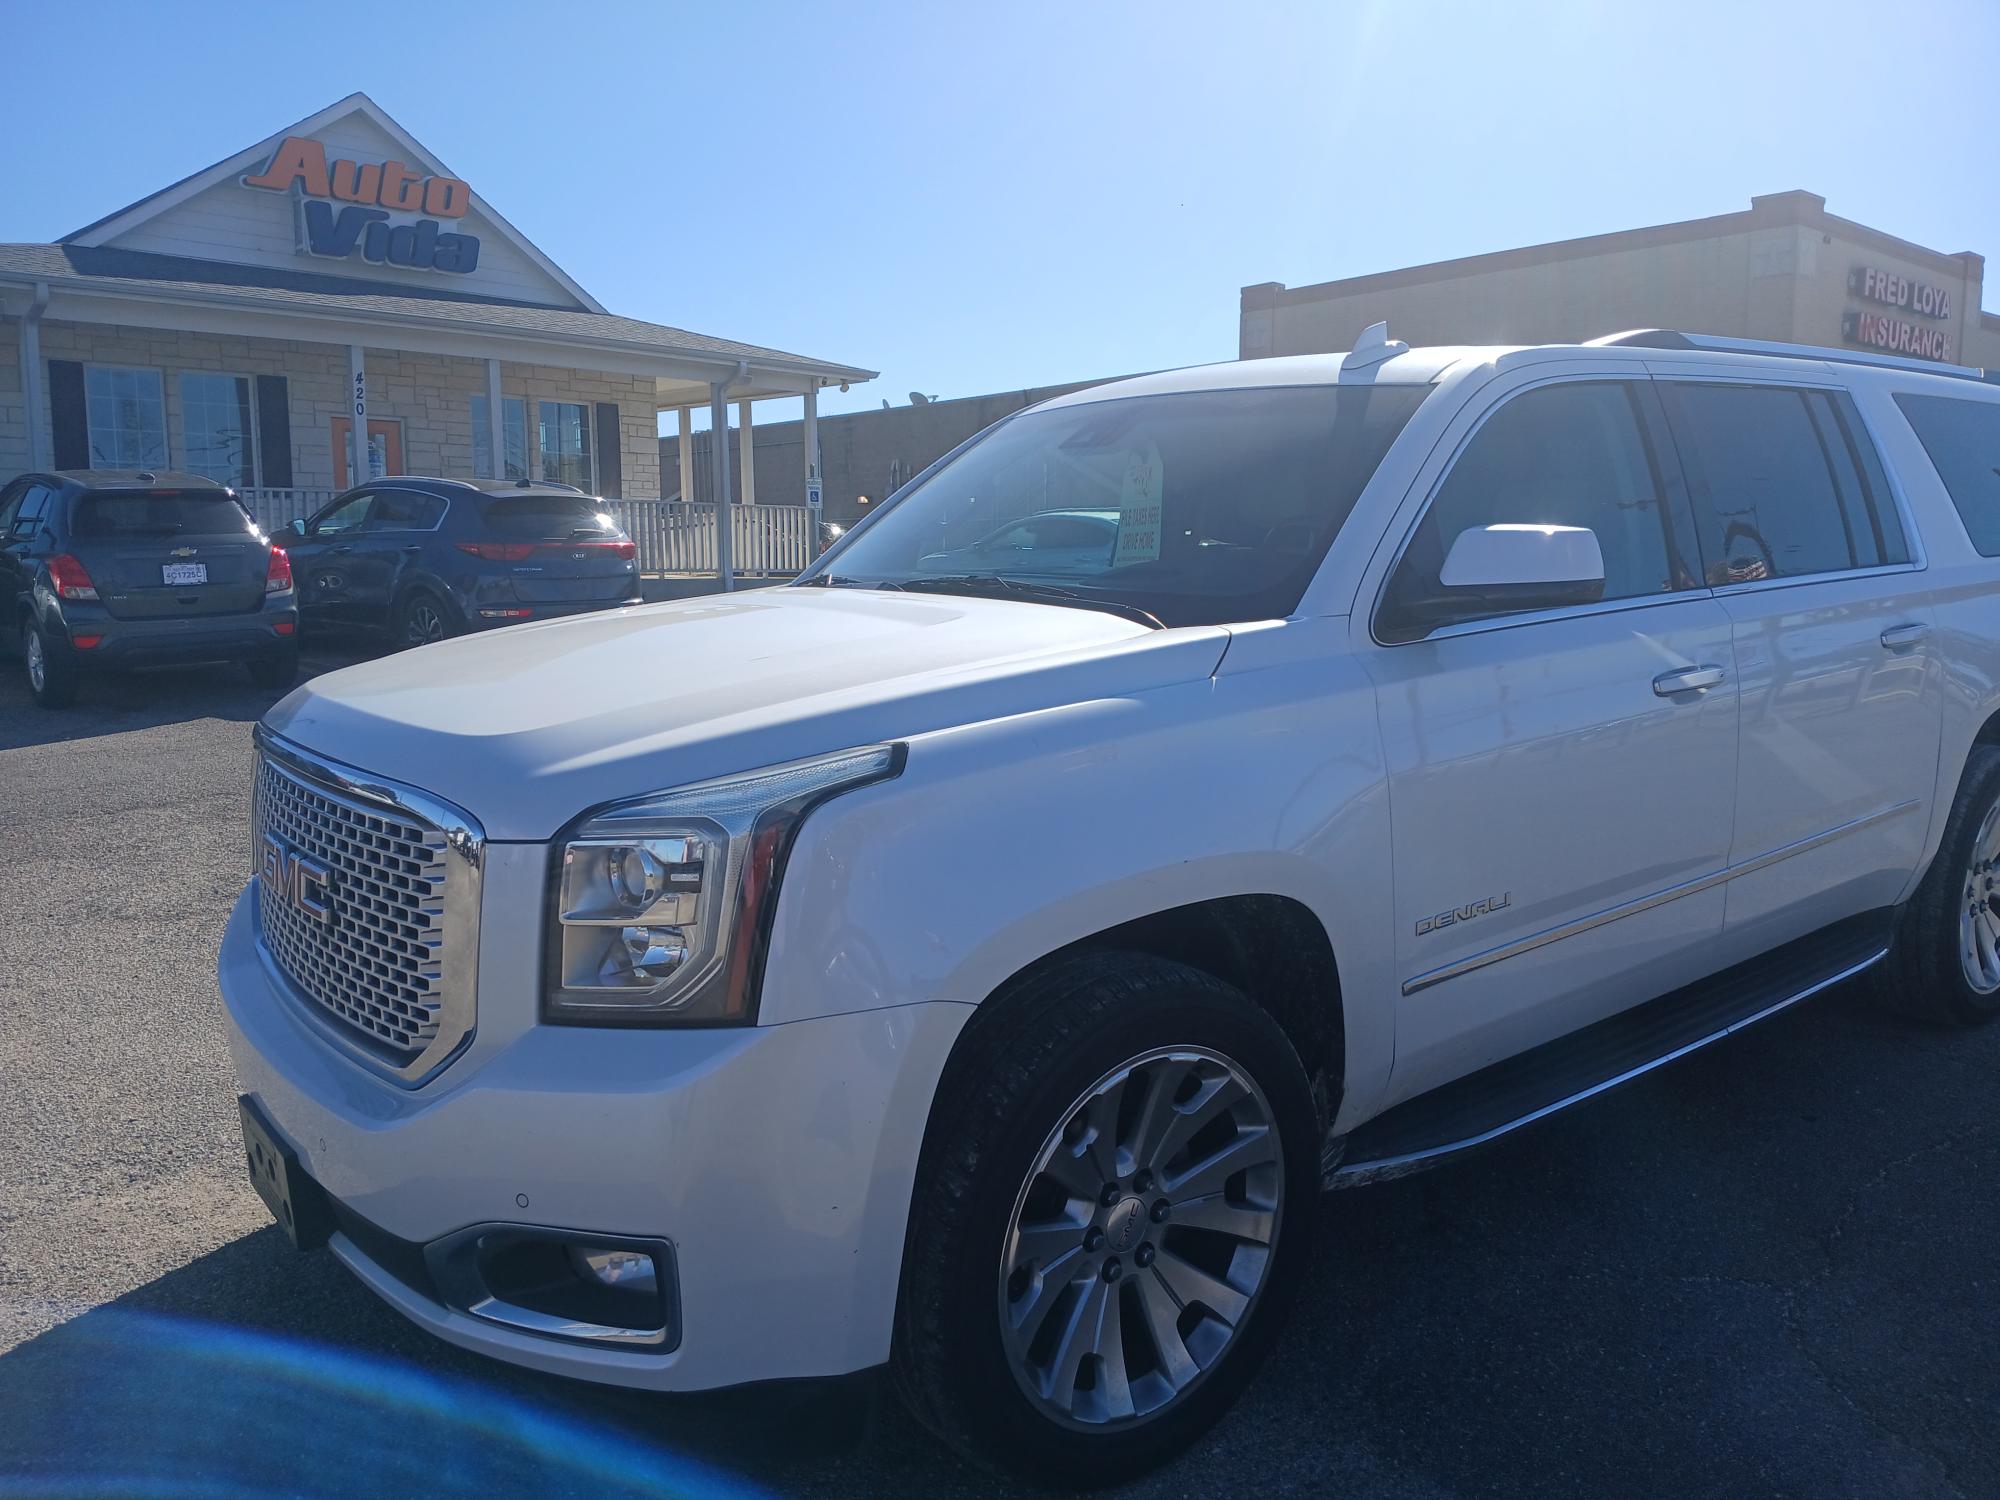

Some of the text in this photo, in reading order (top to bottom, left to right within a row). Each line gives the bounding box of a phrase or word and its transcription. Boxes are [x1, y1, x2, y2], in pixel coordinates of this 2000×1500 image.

[243, 136, 470, 218] Auto
[304, 200, 481, 273] Vida
[1864, 267, 1951, 319] FRED LOYA
[1858, 311, 1952, 361] INSURANCE
[355, 371, 364, 416] 420
[1123, 531, 1154, 550] DRIVE HOME
[262, 832, 330, 923] GMC
[1415, 892, 1511, 937] DENALI
